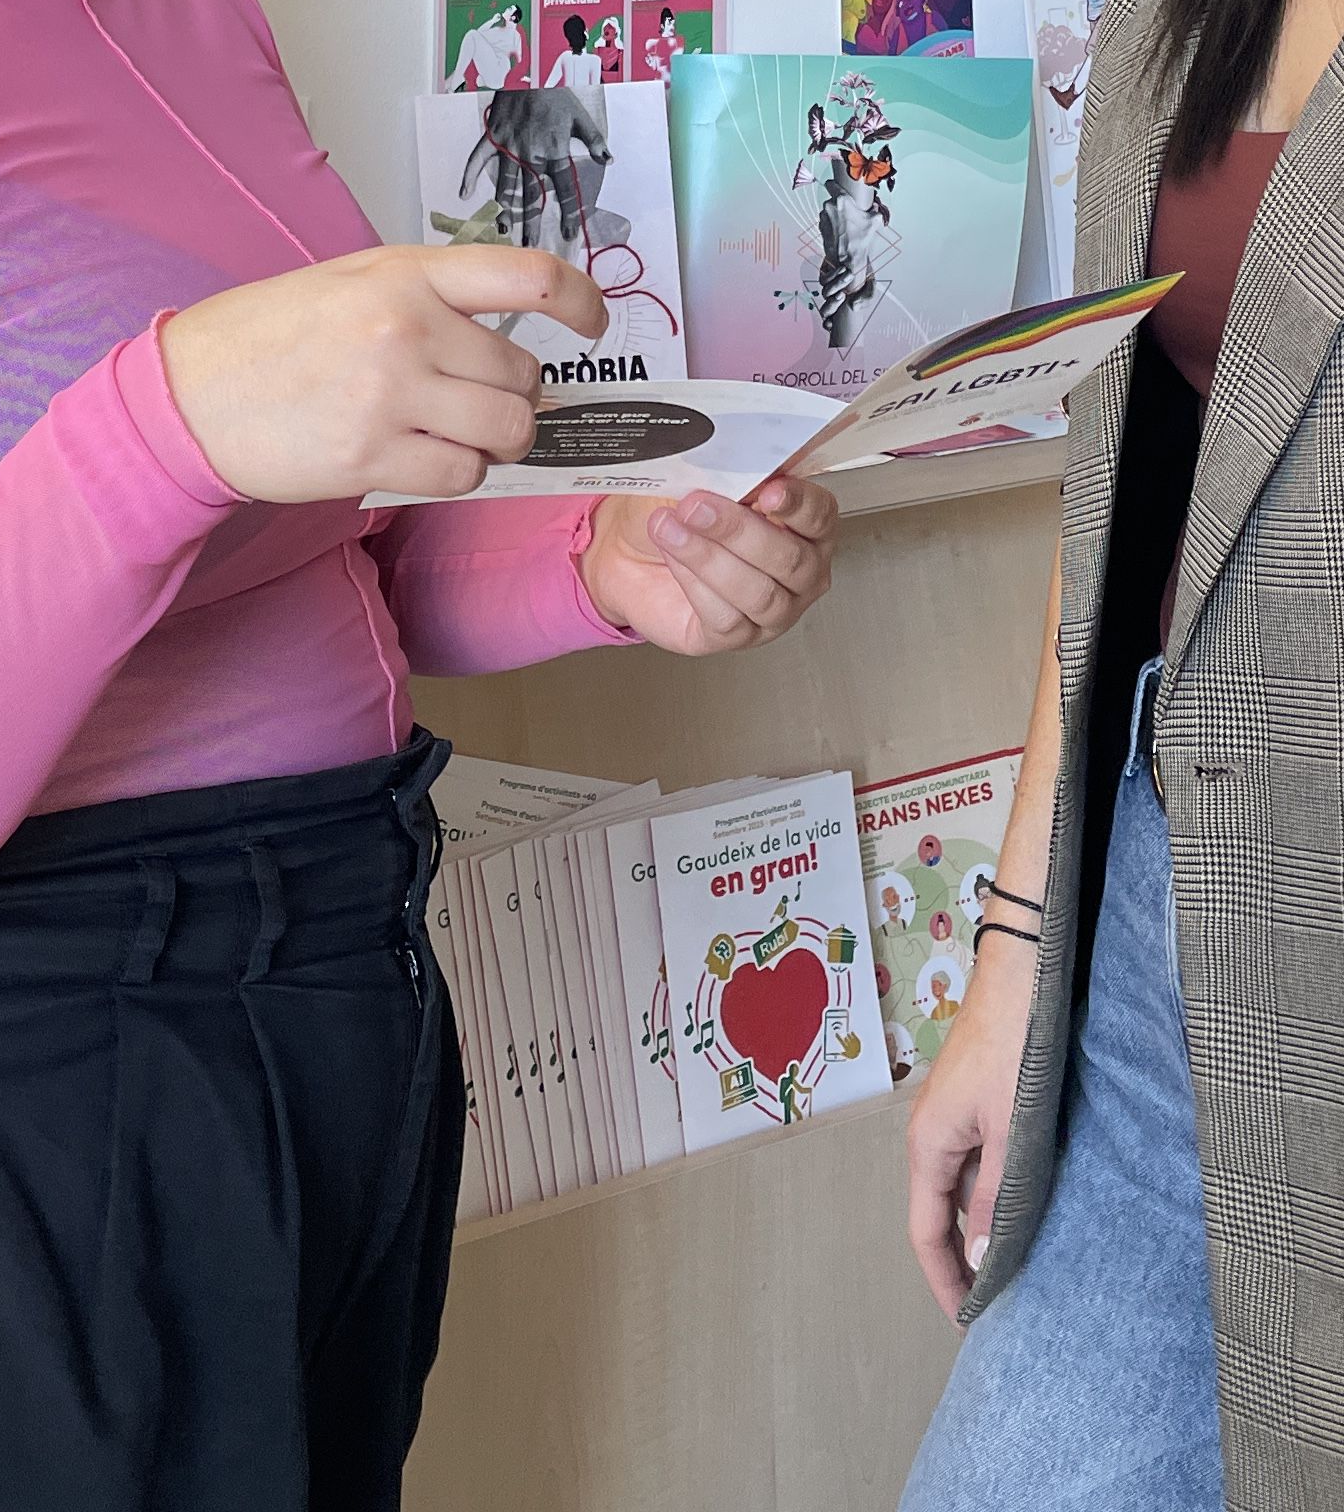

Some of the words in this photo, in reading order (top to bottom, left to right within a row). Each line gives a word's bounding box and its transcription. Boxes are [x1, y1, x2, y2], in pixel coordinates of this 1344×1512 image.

[541, 353, 649, 384] OFÒBIA
[775, 371, 837, 388] SOROLL
[842, 370, 868, 385] DEL
[868, 388, 937, 420] SAI
[947, 358, 1081, 395] LGBTI+
[925, 782, 994, 816] NEXES
[677, 841, 756, 875] Gaudeix
[760, 834, 781, 855] de
[786, 829, 801, 848] la
[806, 818, 842, 842] vida
[711, 870, 744, 898] en
[750, 842, 819, 895] gran!
